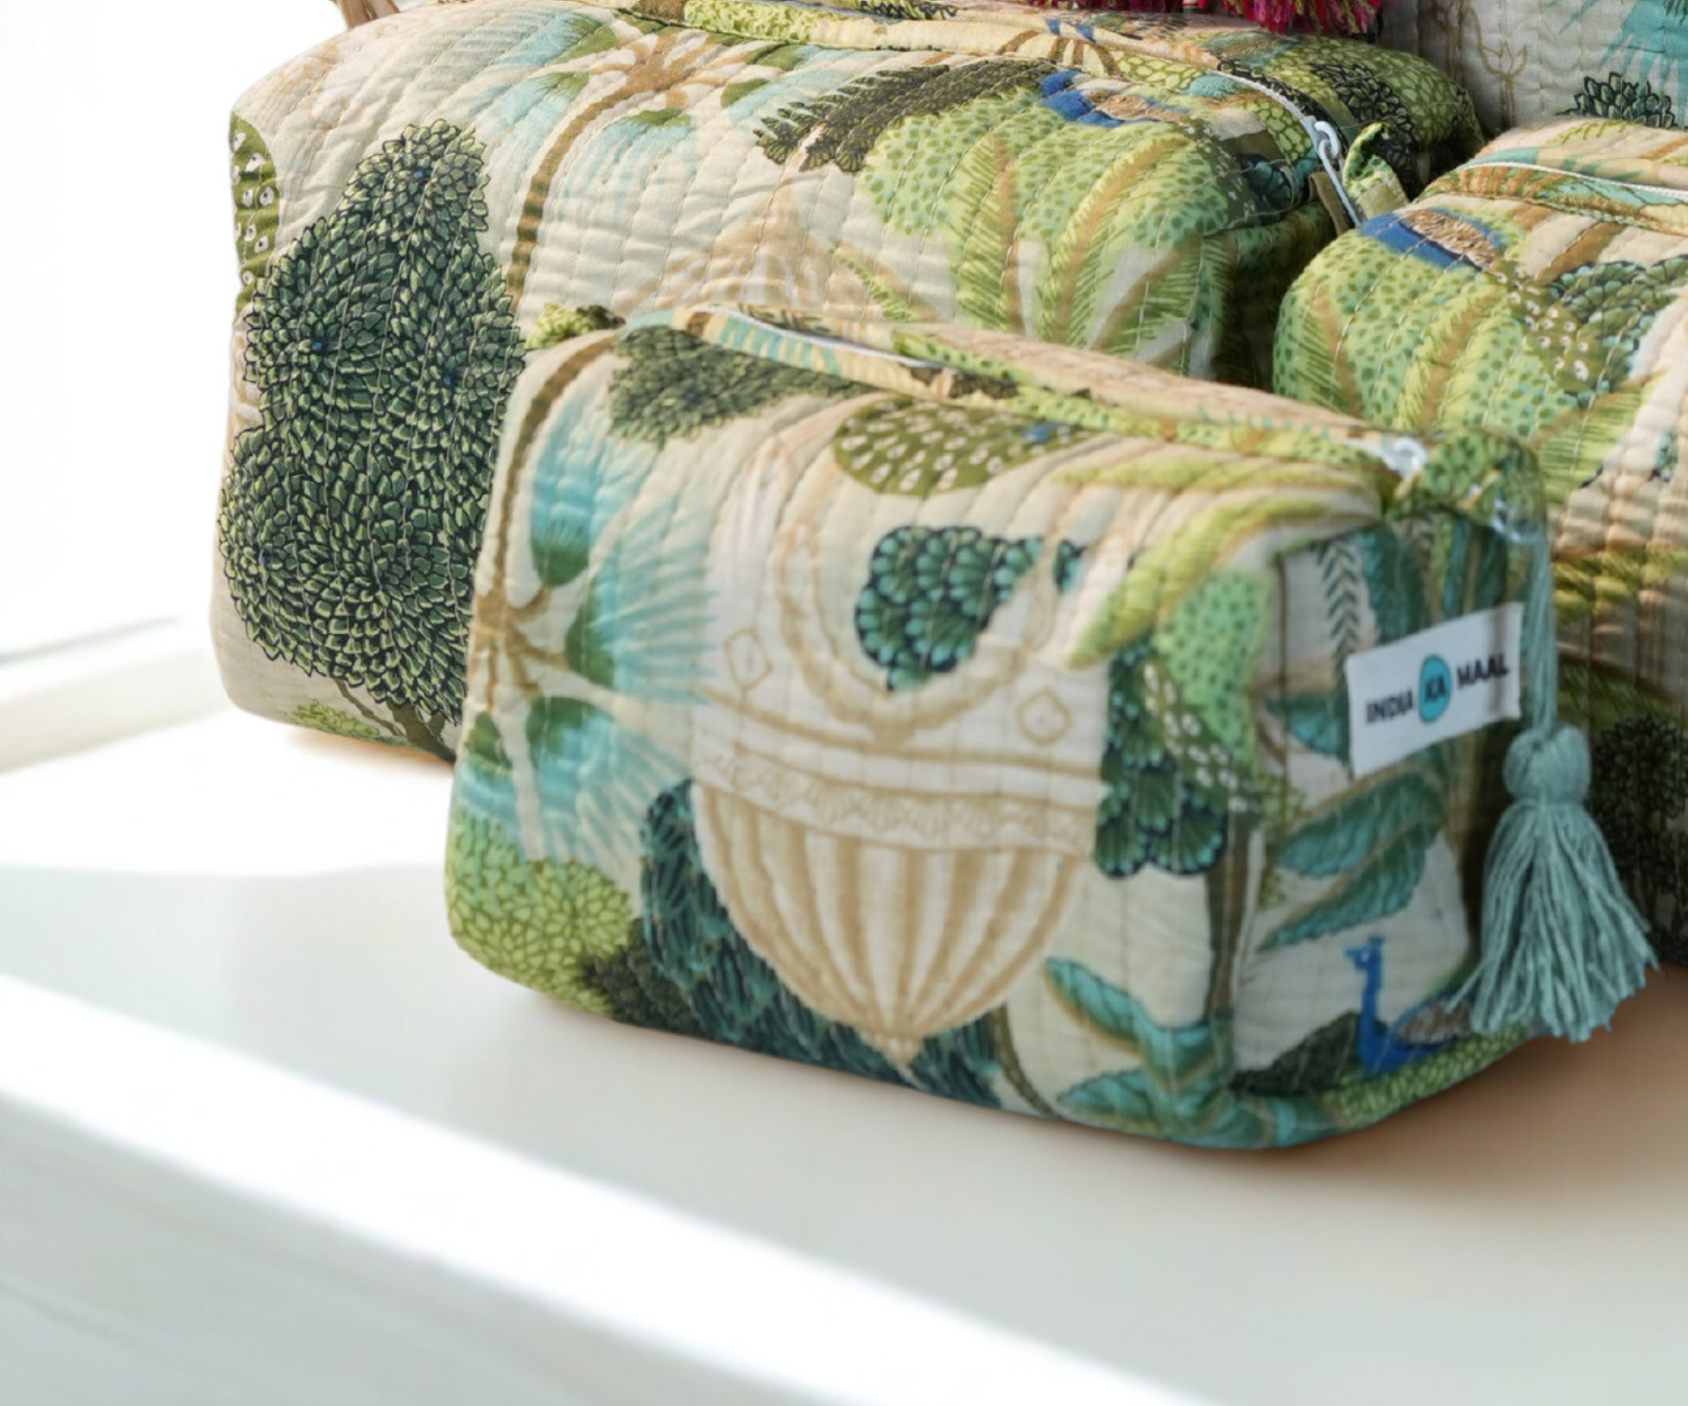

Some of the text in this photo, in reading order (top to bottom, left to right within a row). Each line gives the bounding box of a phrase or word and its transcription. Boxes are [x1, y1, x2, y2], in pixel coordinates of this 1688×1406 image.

[1366, 654, 1508, 724] INDIA KA MAAL
